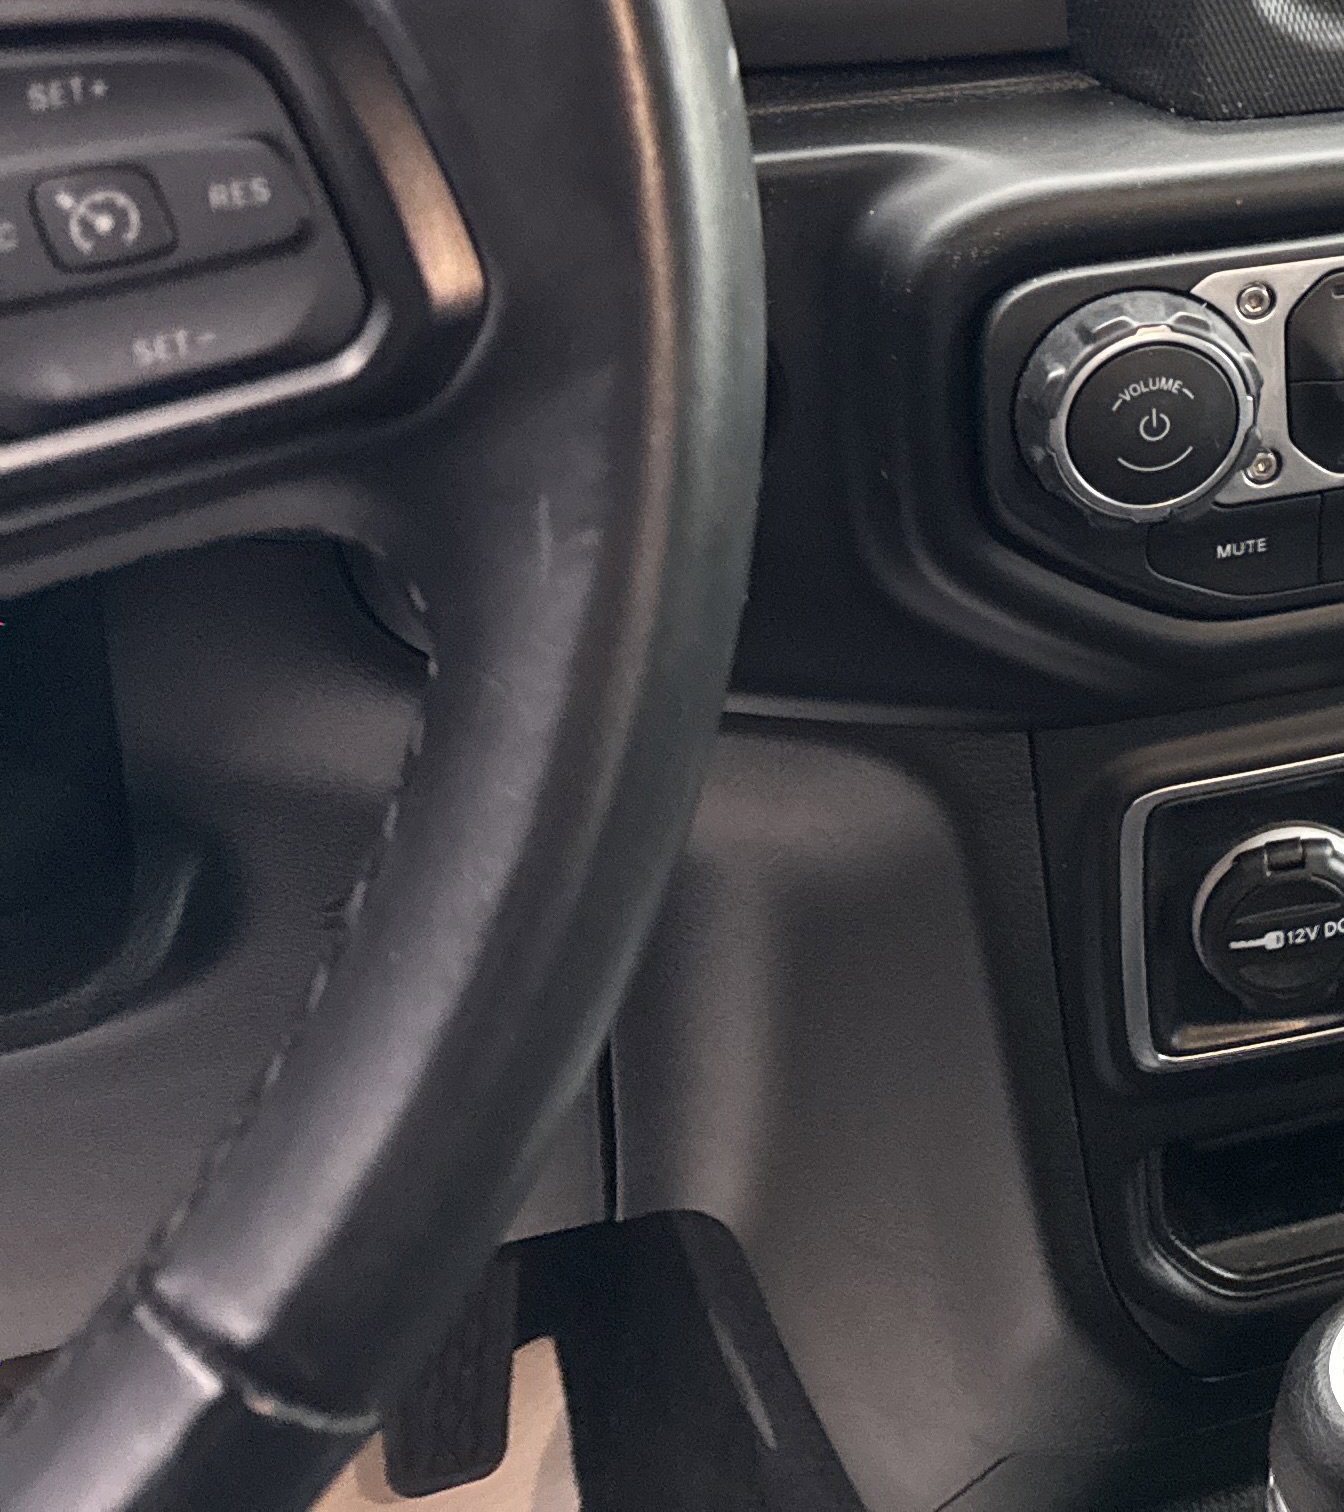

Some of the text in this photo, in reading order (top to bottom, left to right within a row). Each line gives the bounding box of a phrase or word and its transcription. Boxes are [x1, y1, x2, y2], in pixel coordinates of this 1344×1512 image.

[208, 176, 272, 211] RES
[1119, 377, 1183, 402] VOLUME
[1216, 538, 1268, 559] MUTE
[1287, 924, 1320, 945] 12V
